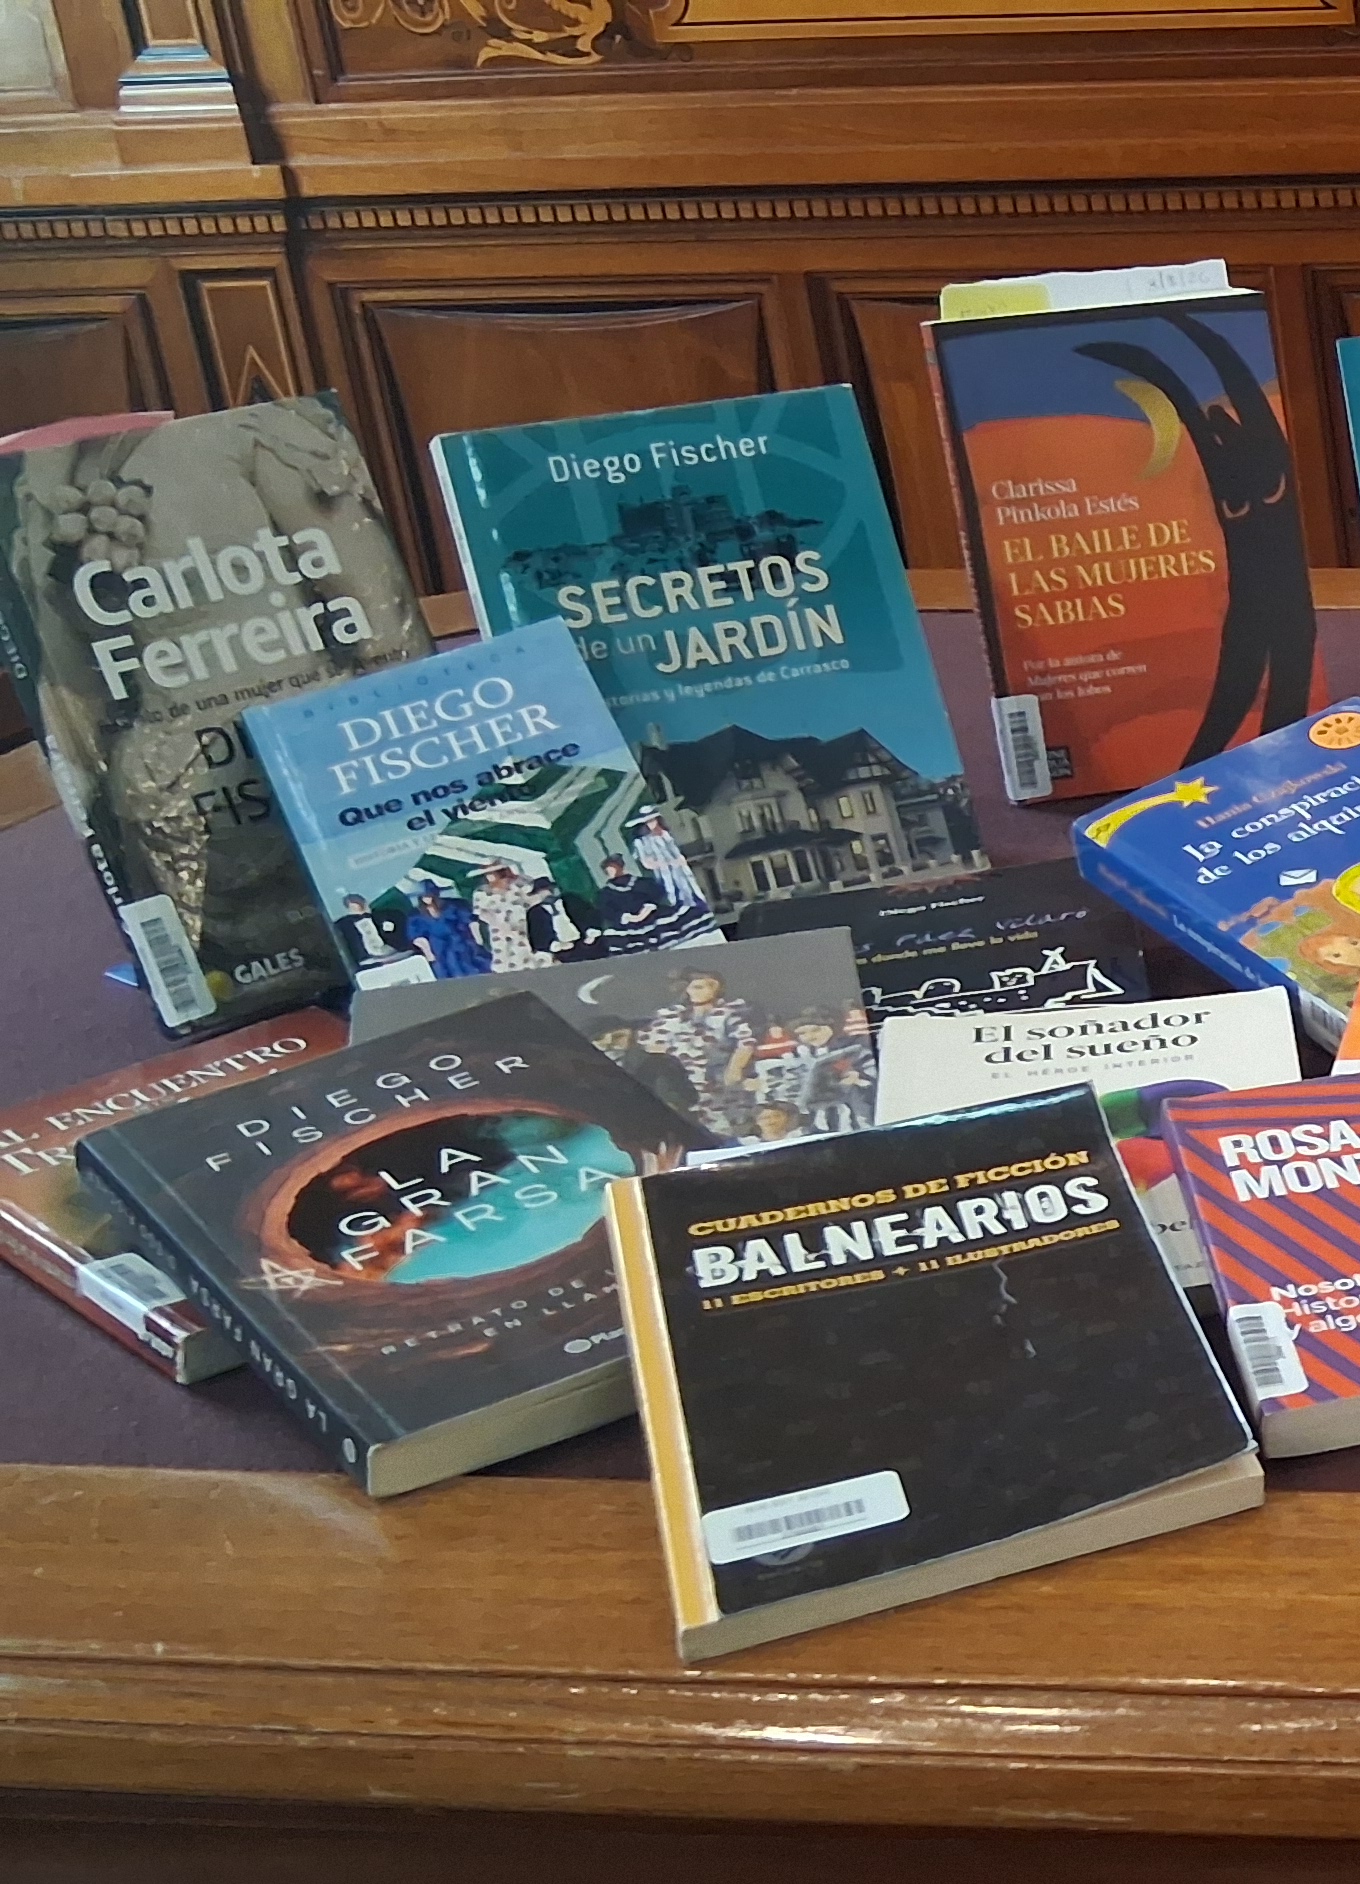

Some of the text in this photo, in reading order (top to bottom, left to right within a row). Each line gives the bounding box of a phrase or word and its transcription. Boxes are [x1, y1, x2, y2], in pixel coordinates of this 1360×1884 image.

[548, 433, 769, 484] Diego Fischer
[992, 477, 1077, 499] Clarissa
[996, 491, 1140, 526] Pinkola Estés
[1003, 519, 1191, 564] EL BAILE DE
[72, 525, 343, 627] Carlota
[557, 550, 830, 629] SECRETOS
[1008, 550, 1216, 597] LAS MUJERES
[1014, 593, 1126, 628] SABIAS
[91, 591, 374, 701] Ferreira
[614, 631, 656, 657] un
[655, 598, 845, 674] JARDÍN
[338, 676, 515, 752] DIEGO
[677, 656, 849, 698] leyendas de Carrasco
[328, 702, 561, 795] FISCHER
[338, 741, 581, 828] Que nos abrace
[406, 783, 538, 831] el viento
[1196, 863, 1233, 885] de
[1232, 842, 1282, 866] los
[233, 947, 306, 984] GALES
[973, 1008, 1211, 1046] El soñador
[985, 1031, 1199, 1066] del sueño
[45, 1037, 307, 1132] ENCUENTRO
[205, 1055, 530, 1172] FISCHER
[237, 1054, 463, 1139] DIEGO
[338, 1144, 569, 1237] GRAN
[378, 1147, 482, 1192] LA
[688, 1150, 1090, 1239] CUADERNOS DE FICCIÓN
[340, 1165, 622, 1270] FARSA
[690, 1177, 1110, 1289] BALNEARIOS
[702, 1218, 1121, 1311] 11 ESCRITORES 11 ILUSTRADORES
[381, 1278, 586, 1355] RETRATO DE
